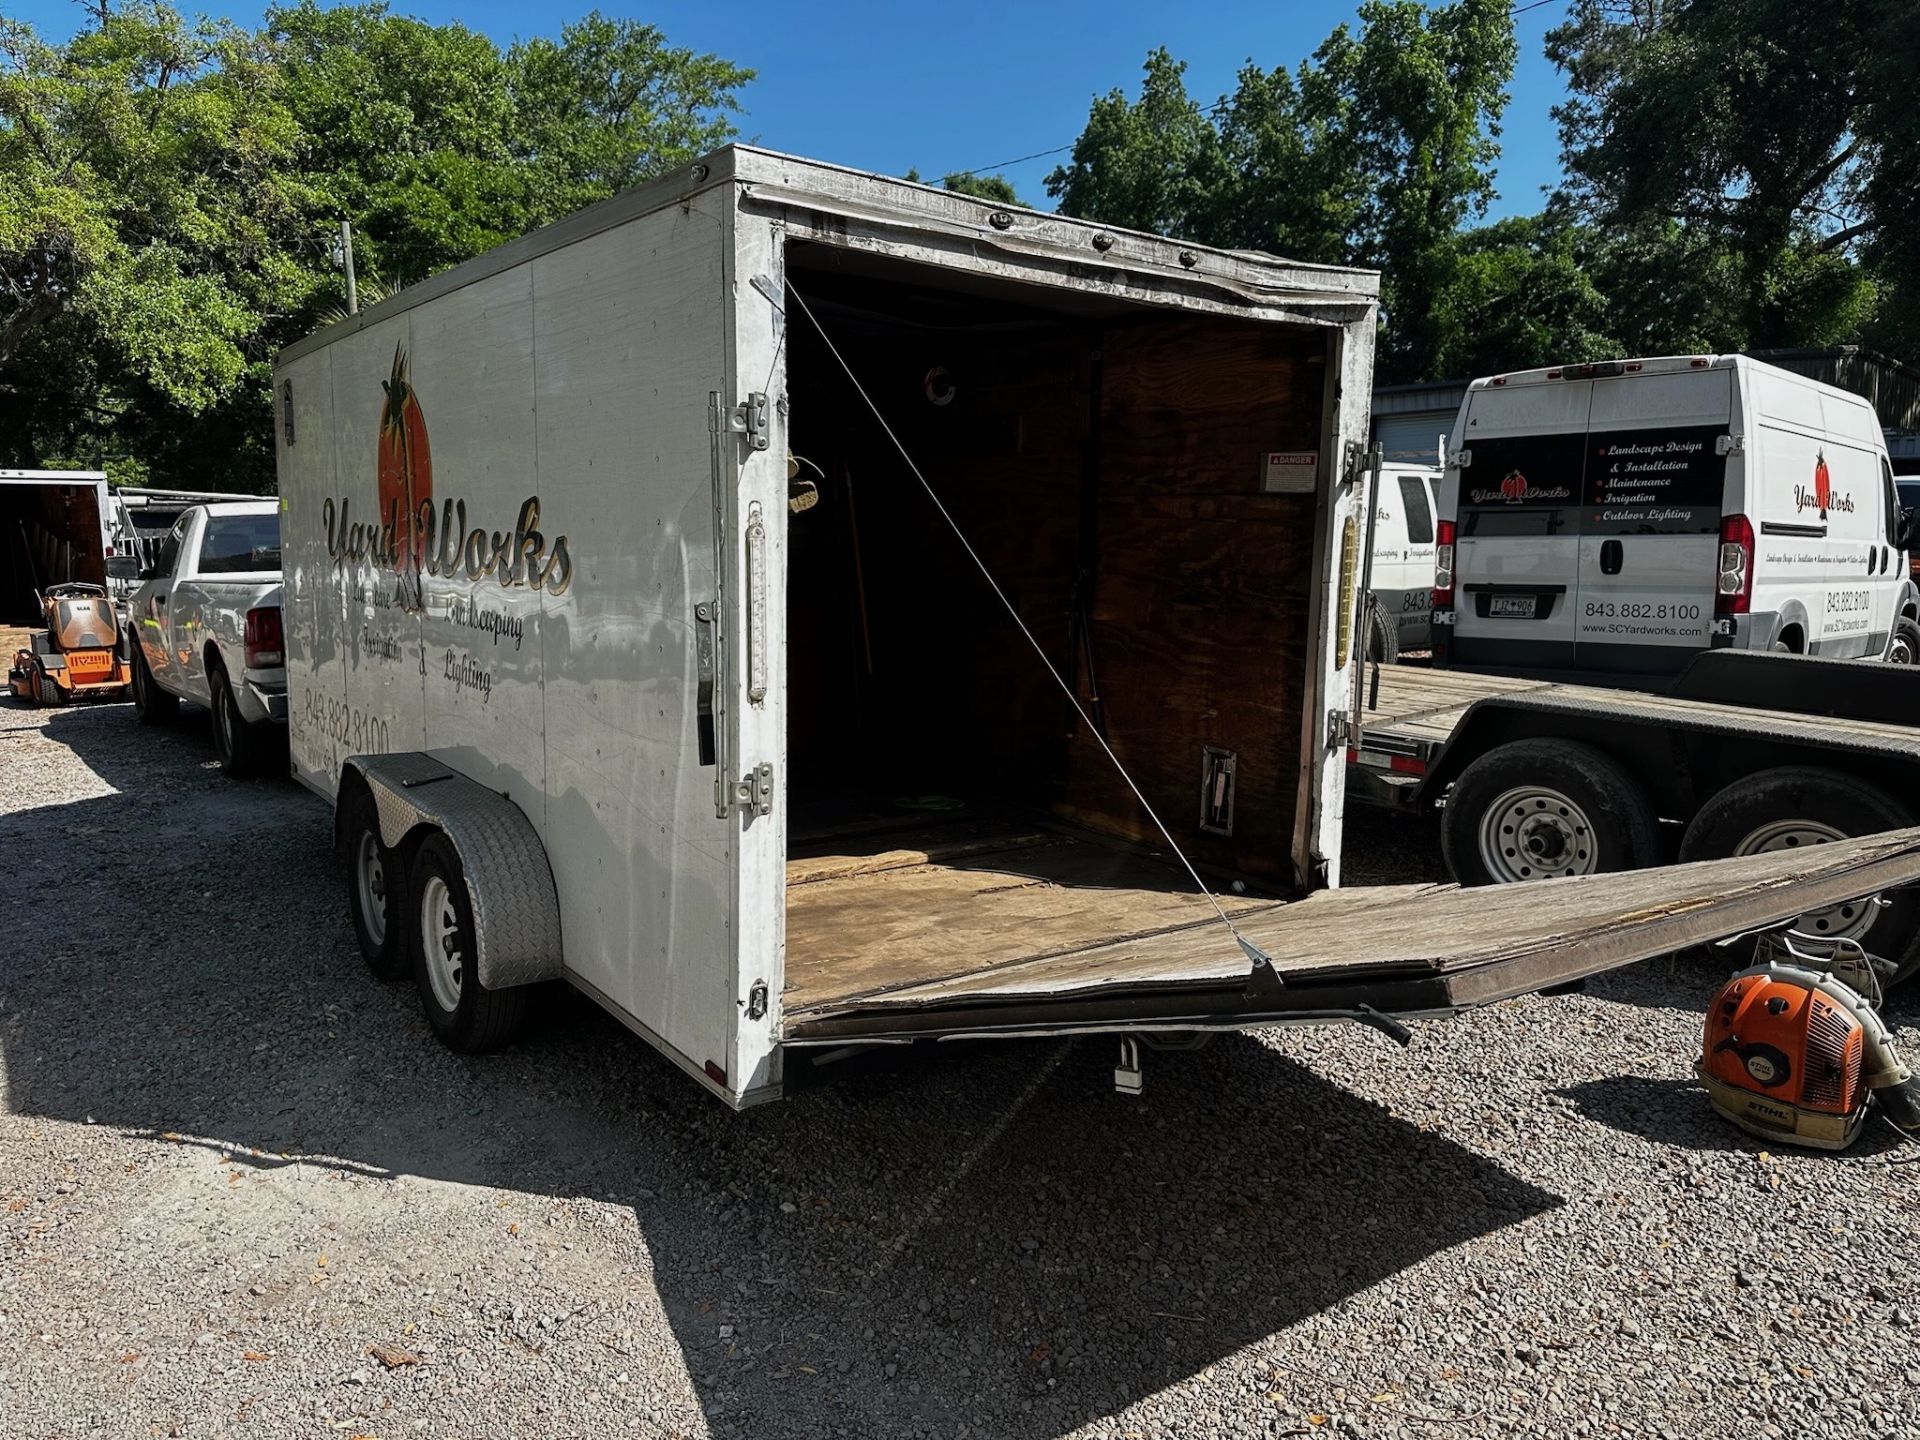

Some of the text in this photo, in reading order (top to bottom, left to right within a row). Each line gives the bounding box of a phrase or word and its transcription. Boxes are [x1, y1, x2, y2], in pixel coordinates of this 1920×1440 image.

[1470, 418, 1477, 426] 4
[1607, 441, 1702, 456] Landscape Design
[1279, 456, 1312, 464] DANGER
[1610, 460, 1689, 473] & Installation
[1605, 478, 1671, 488] Maintenance
[1604, 493, 1656, 505] Irrigation
[1793, 484, 1855, 514] Yard Works
[1603, 508, 1692, 522] Outdoor Lighting
[323, 495, 573, 597] Yard Works
[1827, 590, 1870, 613] 843.882.8100
[1585, 602, 1700, 620] 843.882.8100
[1582, 624, 1702, 637] www.SCYardworks.com
[444, 648, 492, 704] Lighting
[305, 687, 389, 755] 843.882.8100
[1748, 1101, 1789, 1120] STIHL
